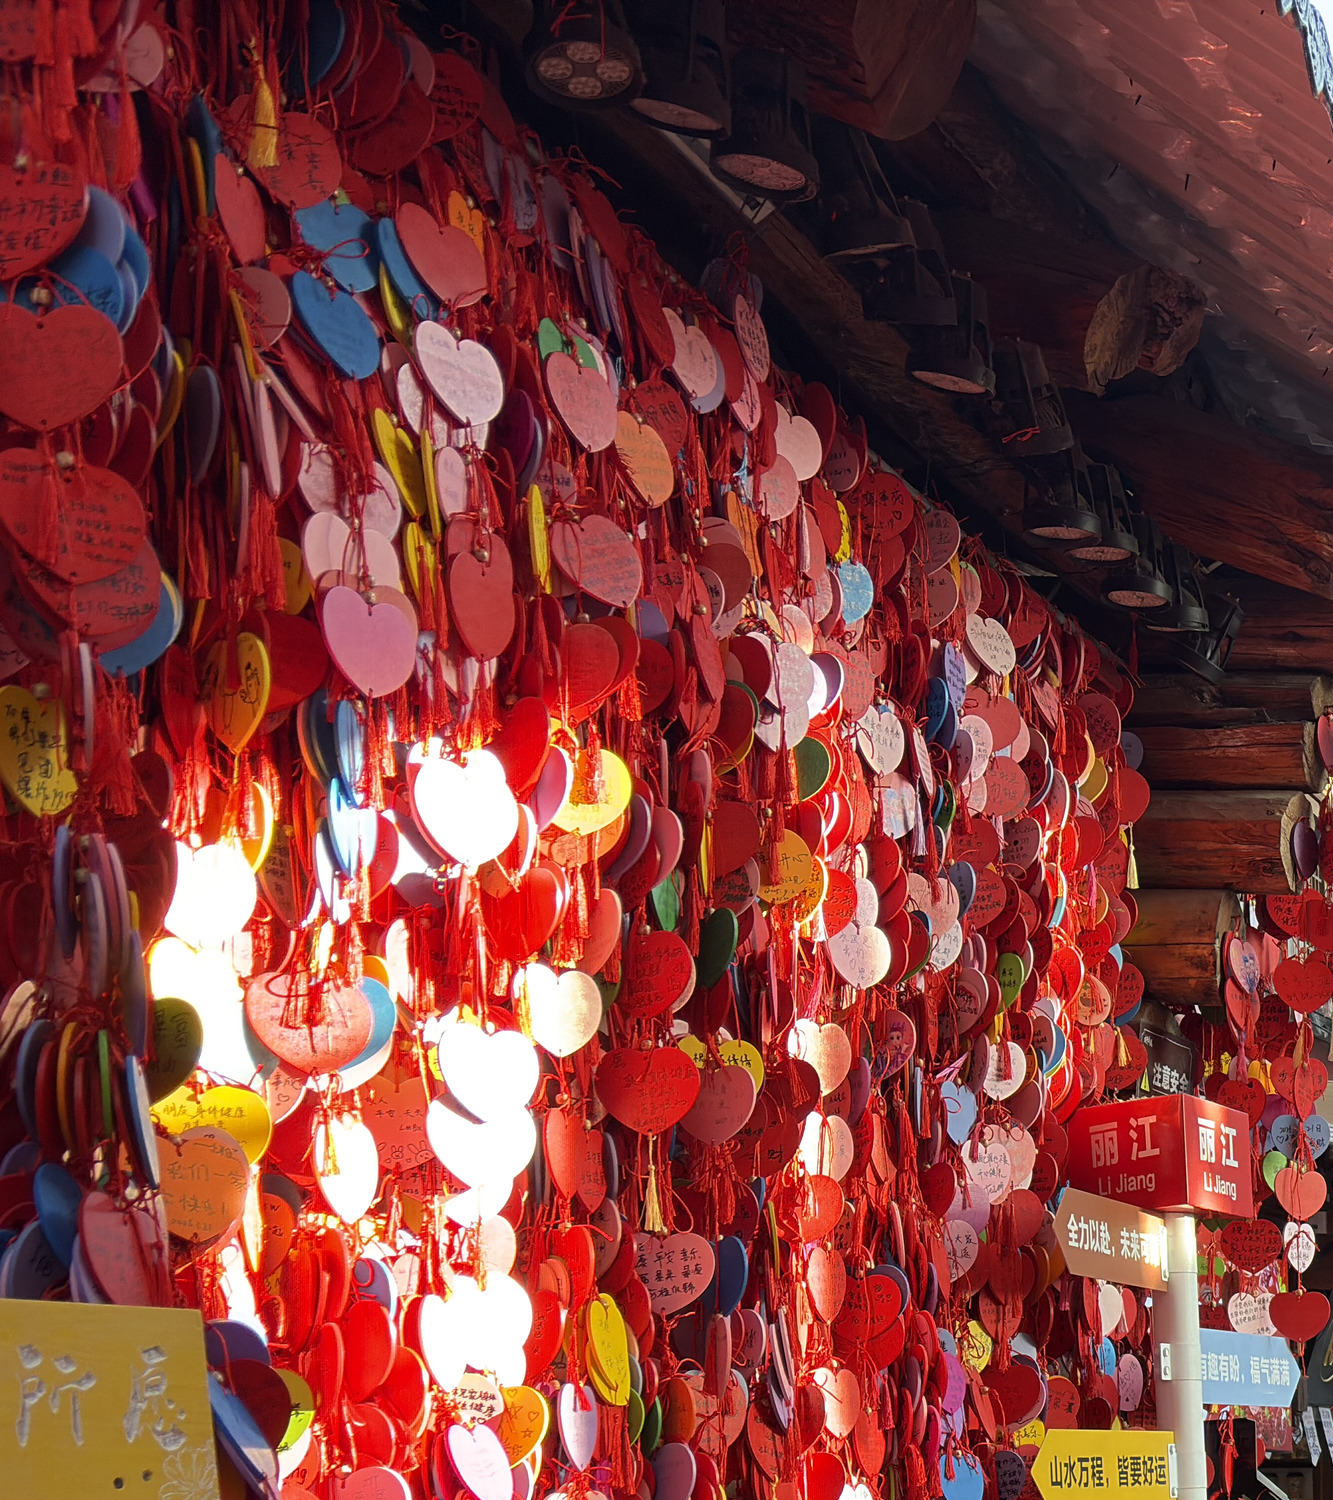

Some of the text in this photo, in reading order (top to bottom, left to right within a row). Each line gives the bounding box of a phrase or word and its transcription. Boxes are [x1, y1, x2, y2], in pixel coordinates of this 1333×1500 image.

[1152, 1062, 1190, 1094] 注意安全
[1088, 1115, 1161, 1169] 丽江
[1197, 1116, 1239, 1169] 丽江
[1098, 1171, 1156, 1196] Li Jiang
[1203, 1171, 1238, 1201] Li Jiang
[1049, 1455, 1167, 1489] 山水万程，皆要好运
